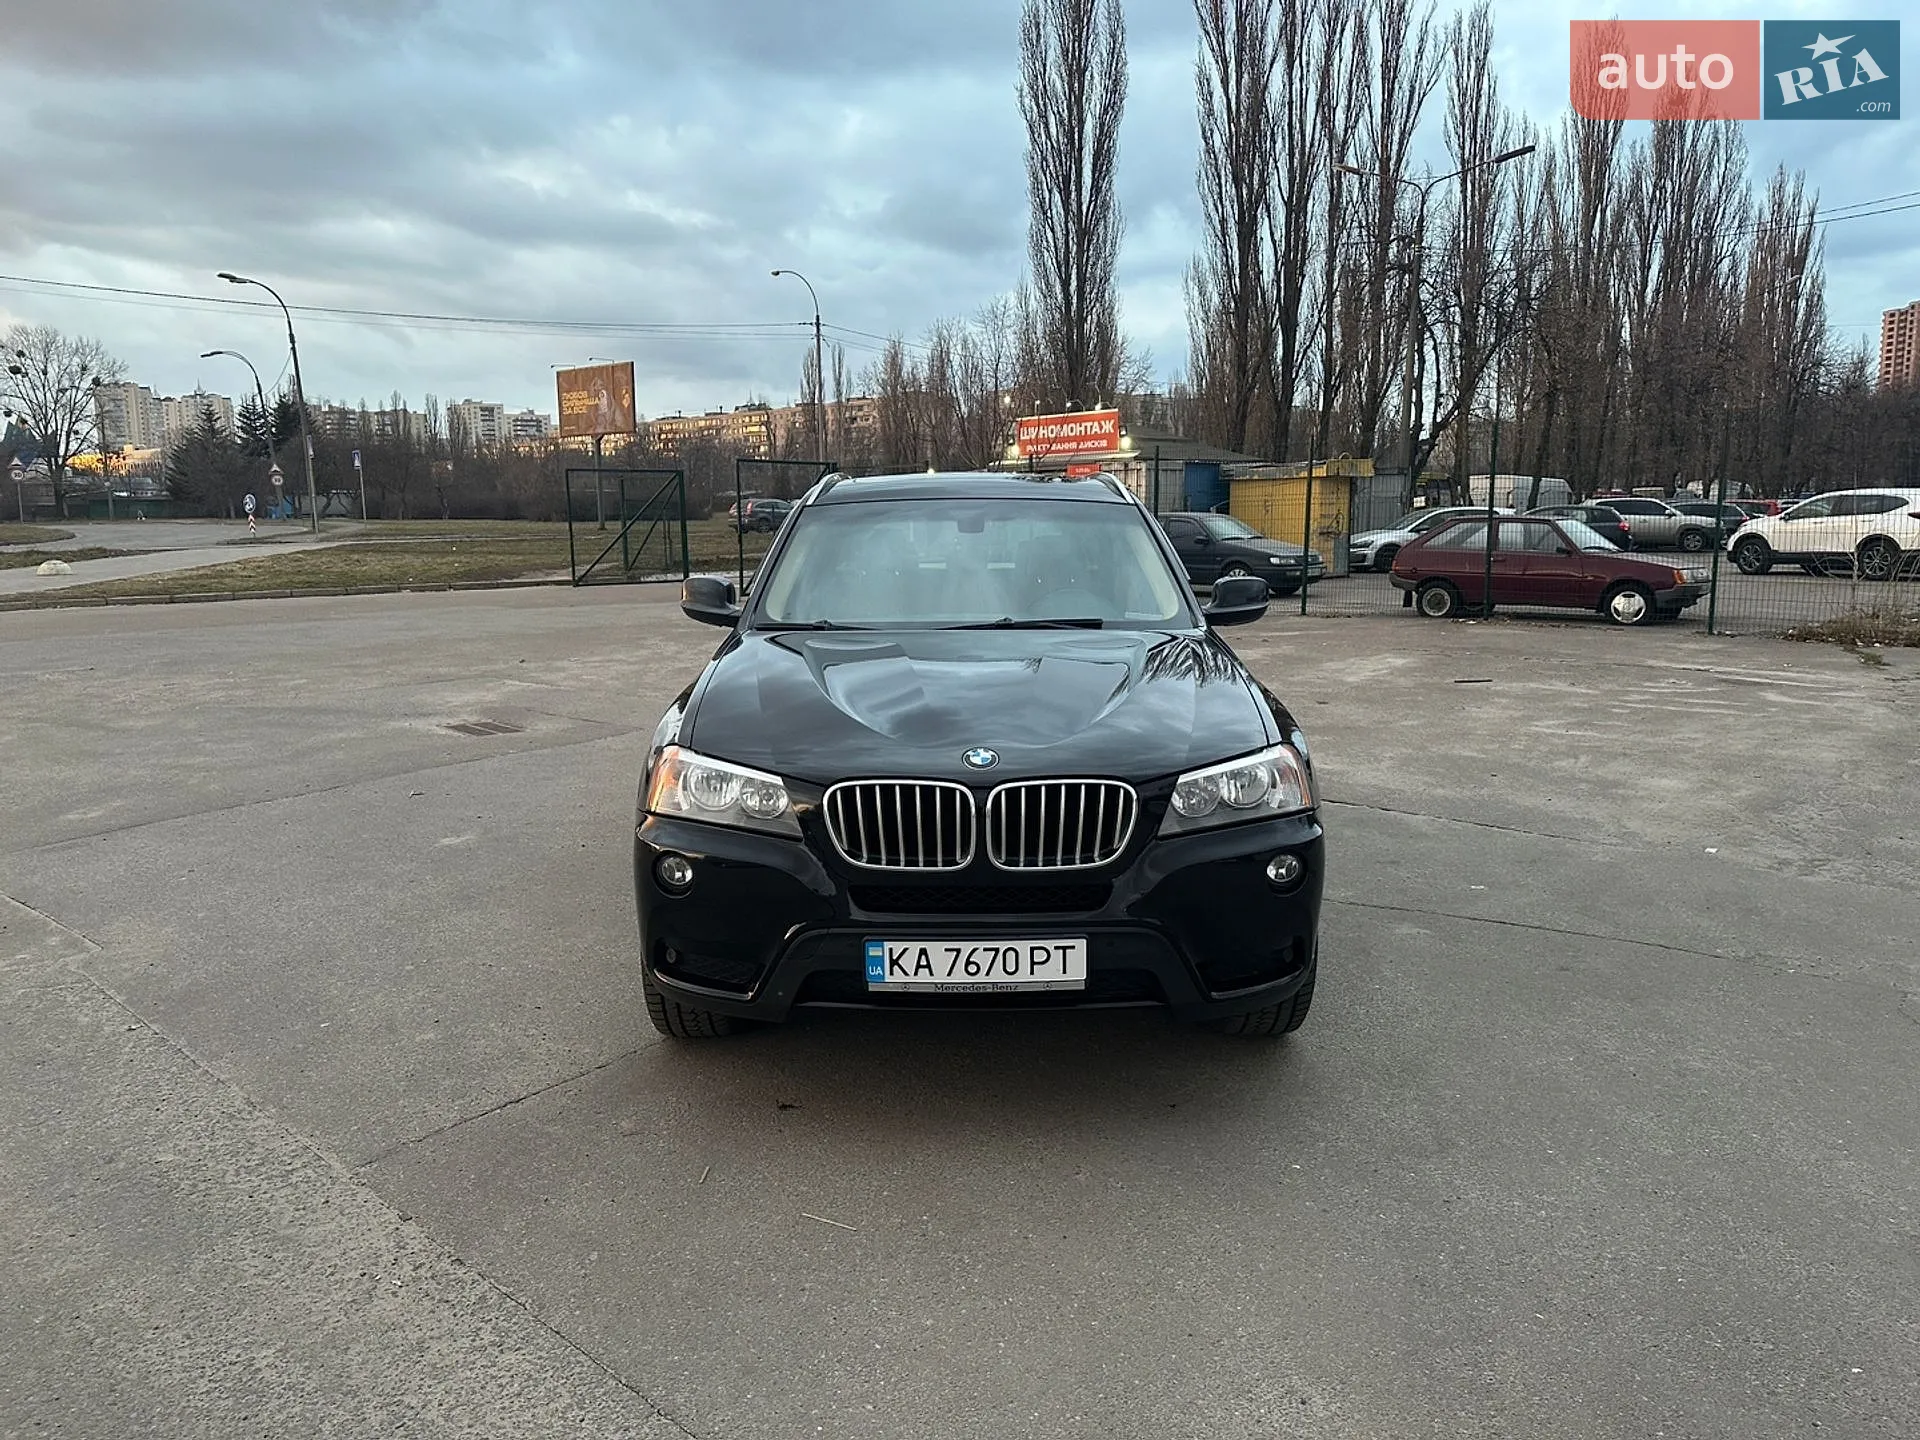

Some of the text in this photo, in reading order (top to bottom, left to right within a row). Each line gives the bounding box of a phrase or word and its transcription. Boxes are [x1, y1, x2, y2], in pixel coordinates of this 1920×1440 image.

[1020, 419, 1115, 440] ШИНОМОНТАЖ
[888, 945, 1076, 977] KA 7670 PT
[869, 966, 883, 976] UA
[934, 983, 1019, 993] Mercedes-Benz
